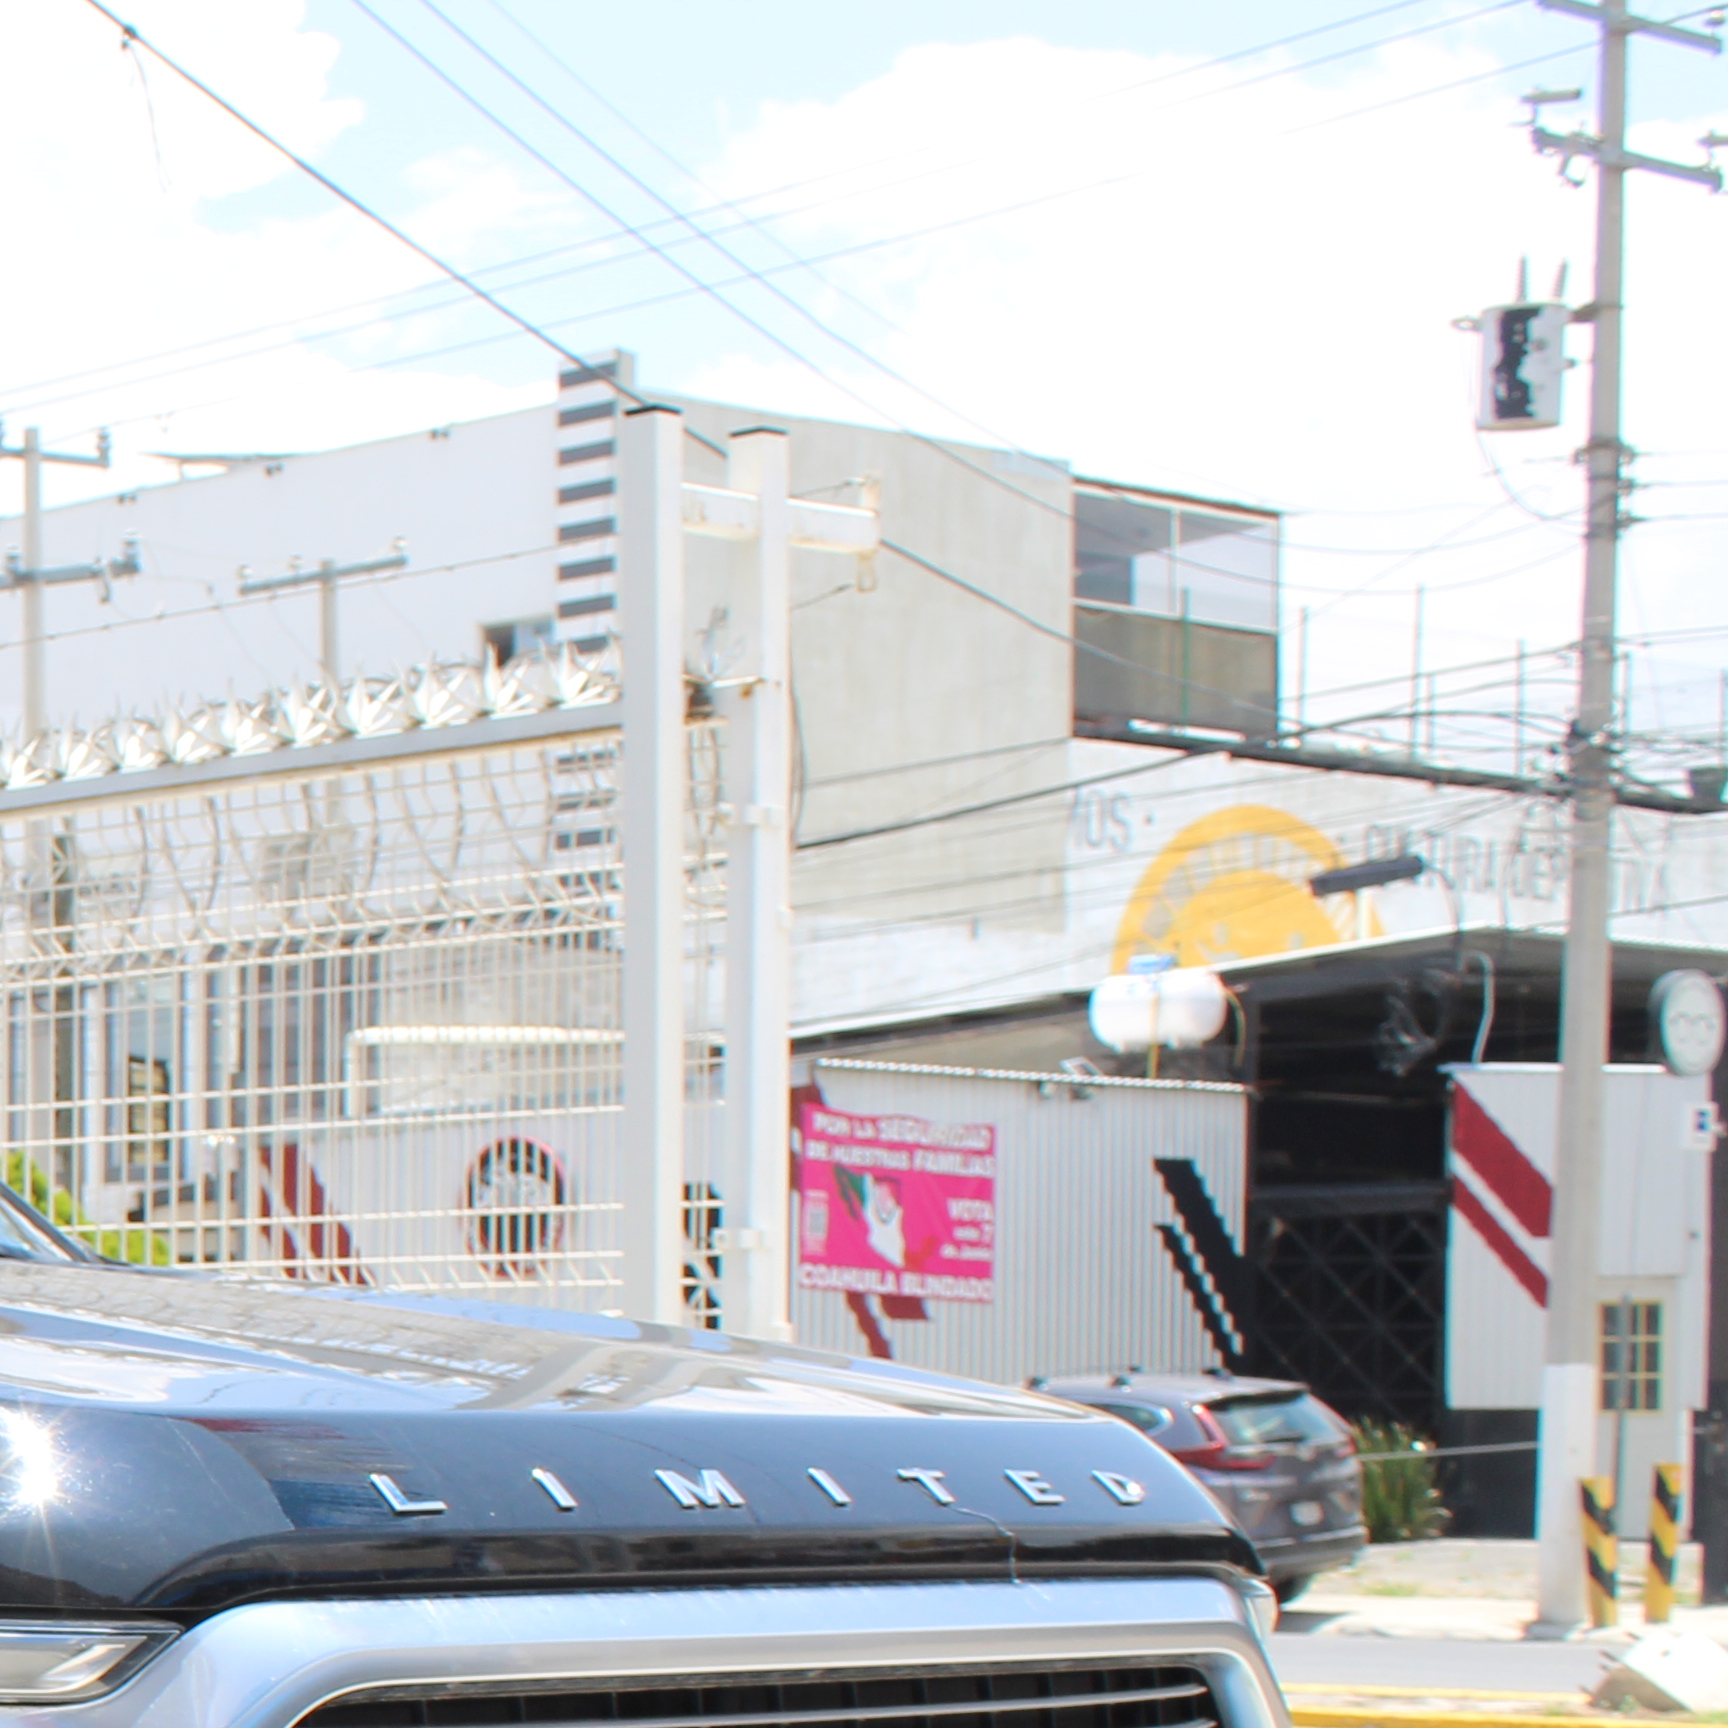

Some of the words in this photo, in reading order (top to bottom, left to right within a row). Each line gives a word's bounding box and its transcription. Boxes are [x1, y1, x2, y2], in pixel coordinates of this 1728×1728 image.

[812, 1111, 851, 1135] POR
[853, 1117, 877, 1140] LA
[804, 1139, 829, 1161] DE
[831, 1143, 911, 1171] NUESTRAS
[912, 1148, 996, 1179] FAMILIAS
[799, 1262, 899, 1295] COAHUILA
[369, 1465, 1146, 1514] LIMITED
